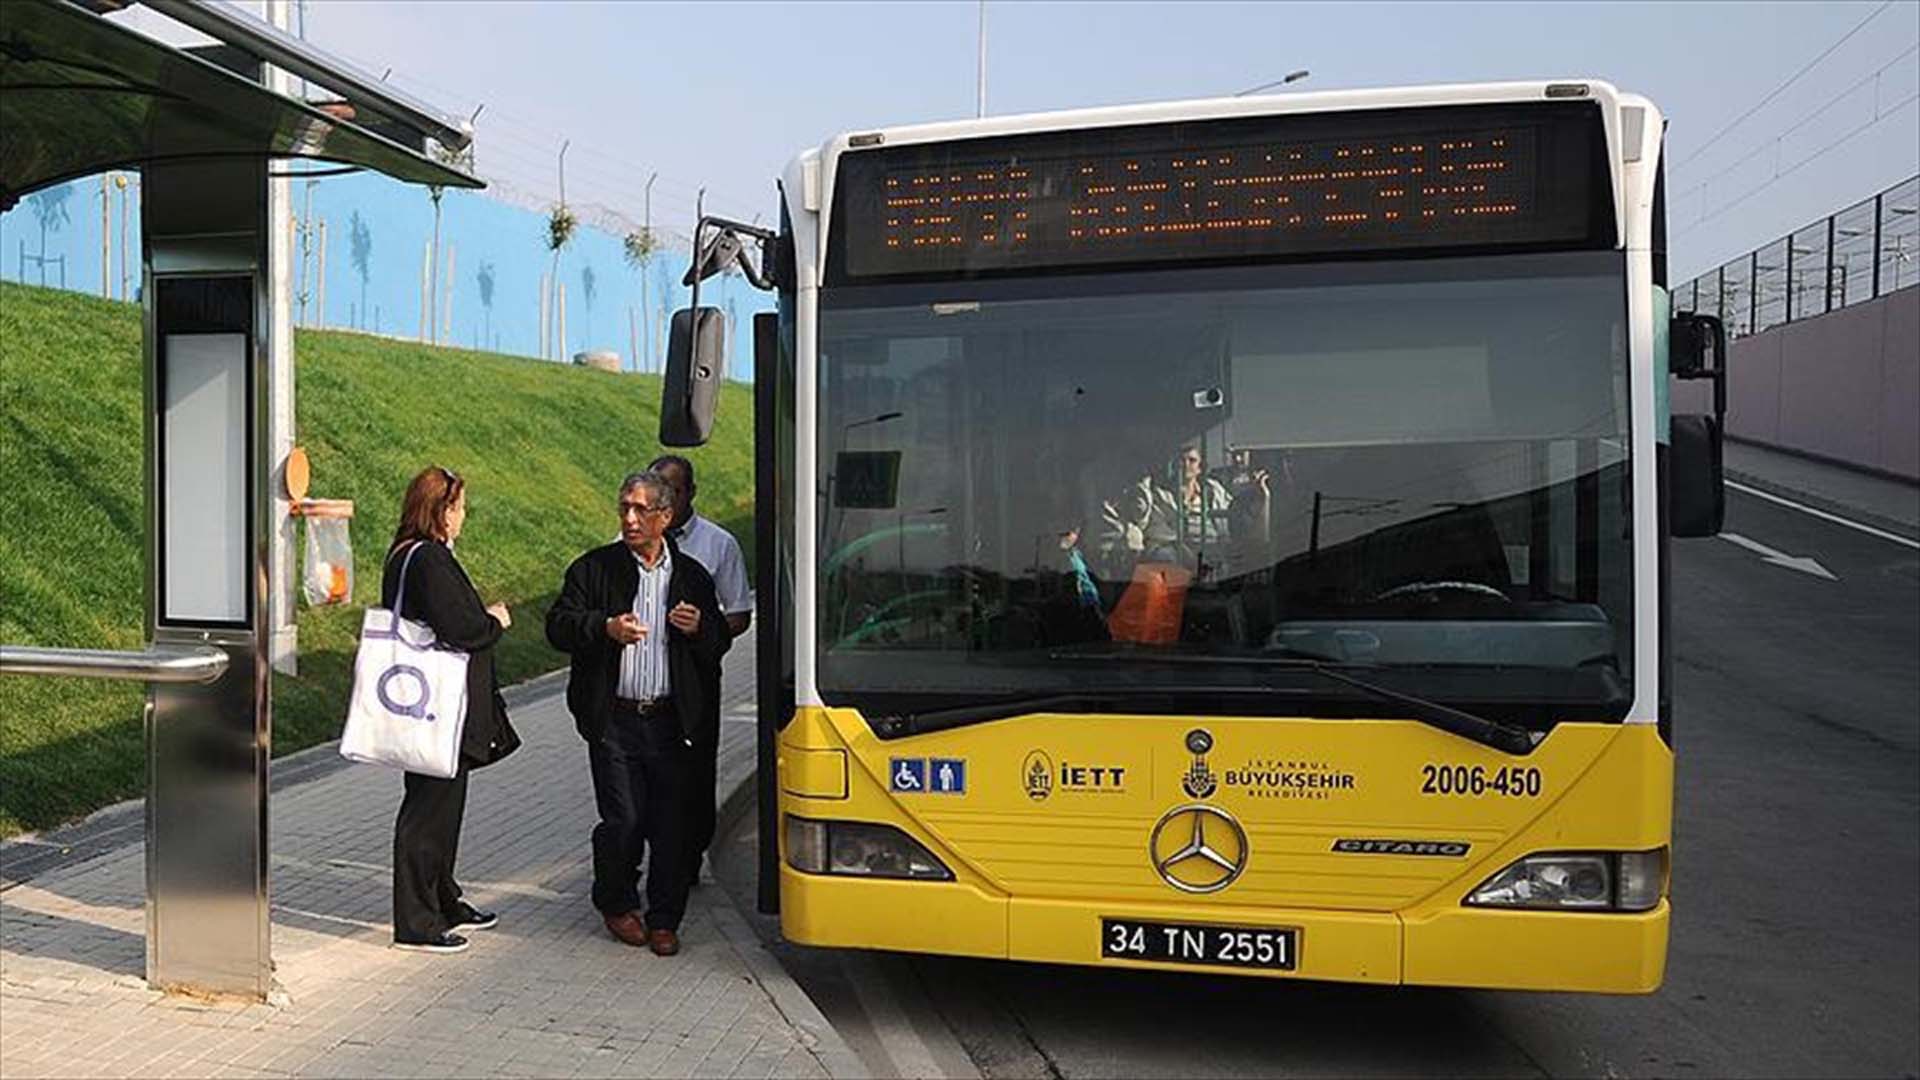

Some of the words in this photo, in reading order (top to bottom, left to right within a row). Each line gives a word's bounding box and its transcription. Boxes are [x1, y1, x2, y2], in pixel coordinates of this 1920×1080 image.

[1061, 762, 1125, 785] İETT
[1226, 766, 1355, 790] BÜYÜKŞEHİR
[1422, 765, 1541, 797] 2006-450
[1339, 841, 1465, 854] CITARO
[1110, 925, 1146, 954] 34
[1164, 928, 1205, 958] TN
[1217, 932, 1286, 964] 2551
